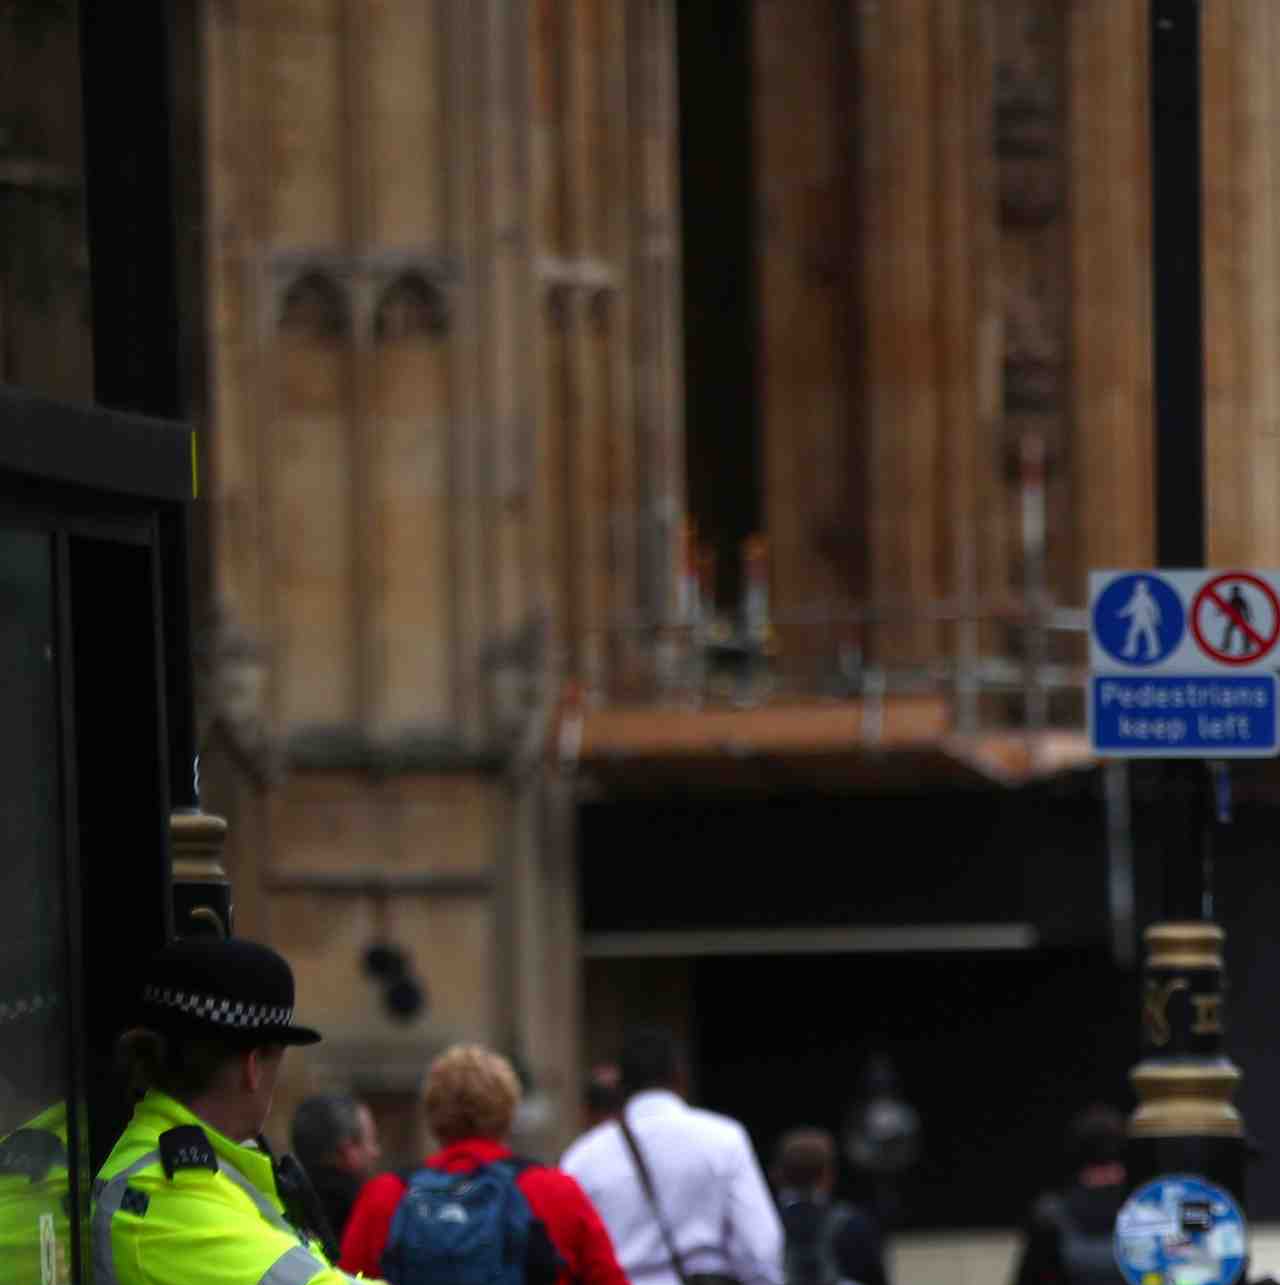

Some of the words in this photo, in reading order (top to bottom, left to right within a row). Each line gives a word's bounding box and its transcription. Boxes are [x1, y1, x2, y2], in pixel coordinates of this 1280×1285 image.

[1101, 682, 1267, 708] Pedestrians
[1118, 715, 1187, 743] keep
[1197, 714, 1251, 740] left
